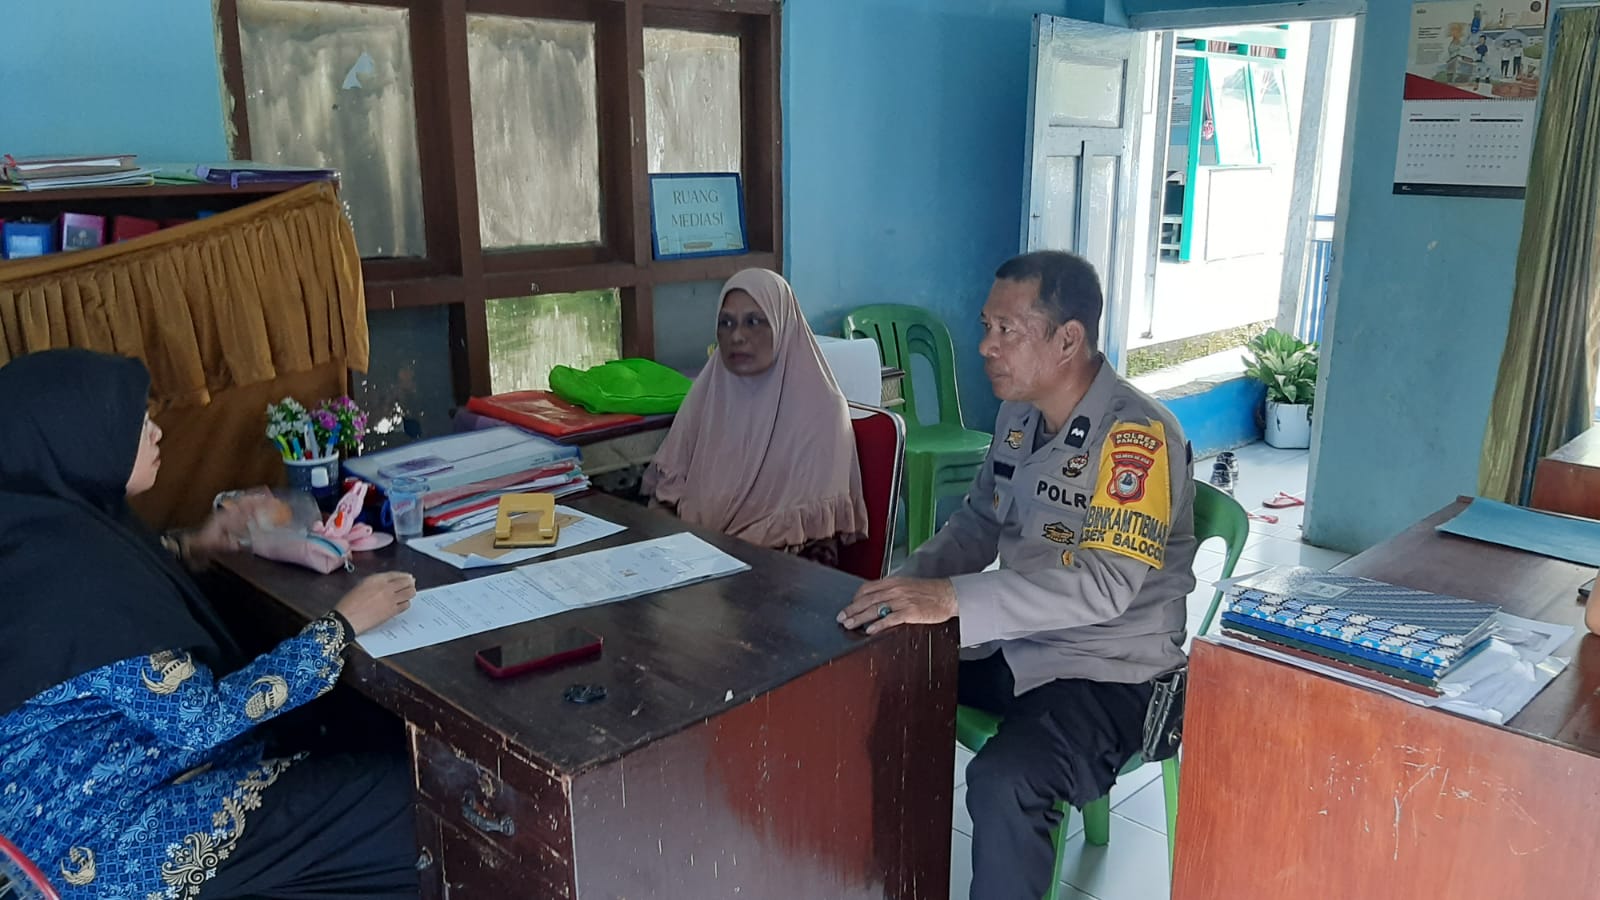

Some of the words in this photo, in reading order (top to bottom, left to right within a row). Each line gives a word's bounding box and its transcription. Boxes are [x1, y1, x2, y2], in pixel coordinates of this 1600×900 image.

[673, 190, 718, 204] RUANG
[671, 212, 723, 227] MEDIASI
[1116, 432, 1157, 446] POLRES
